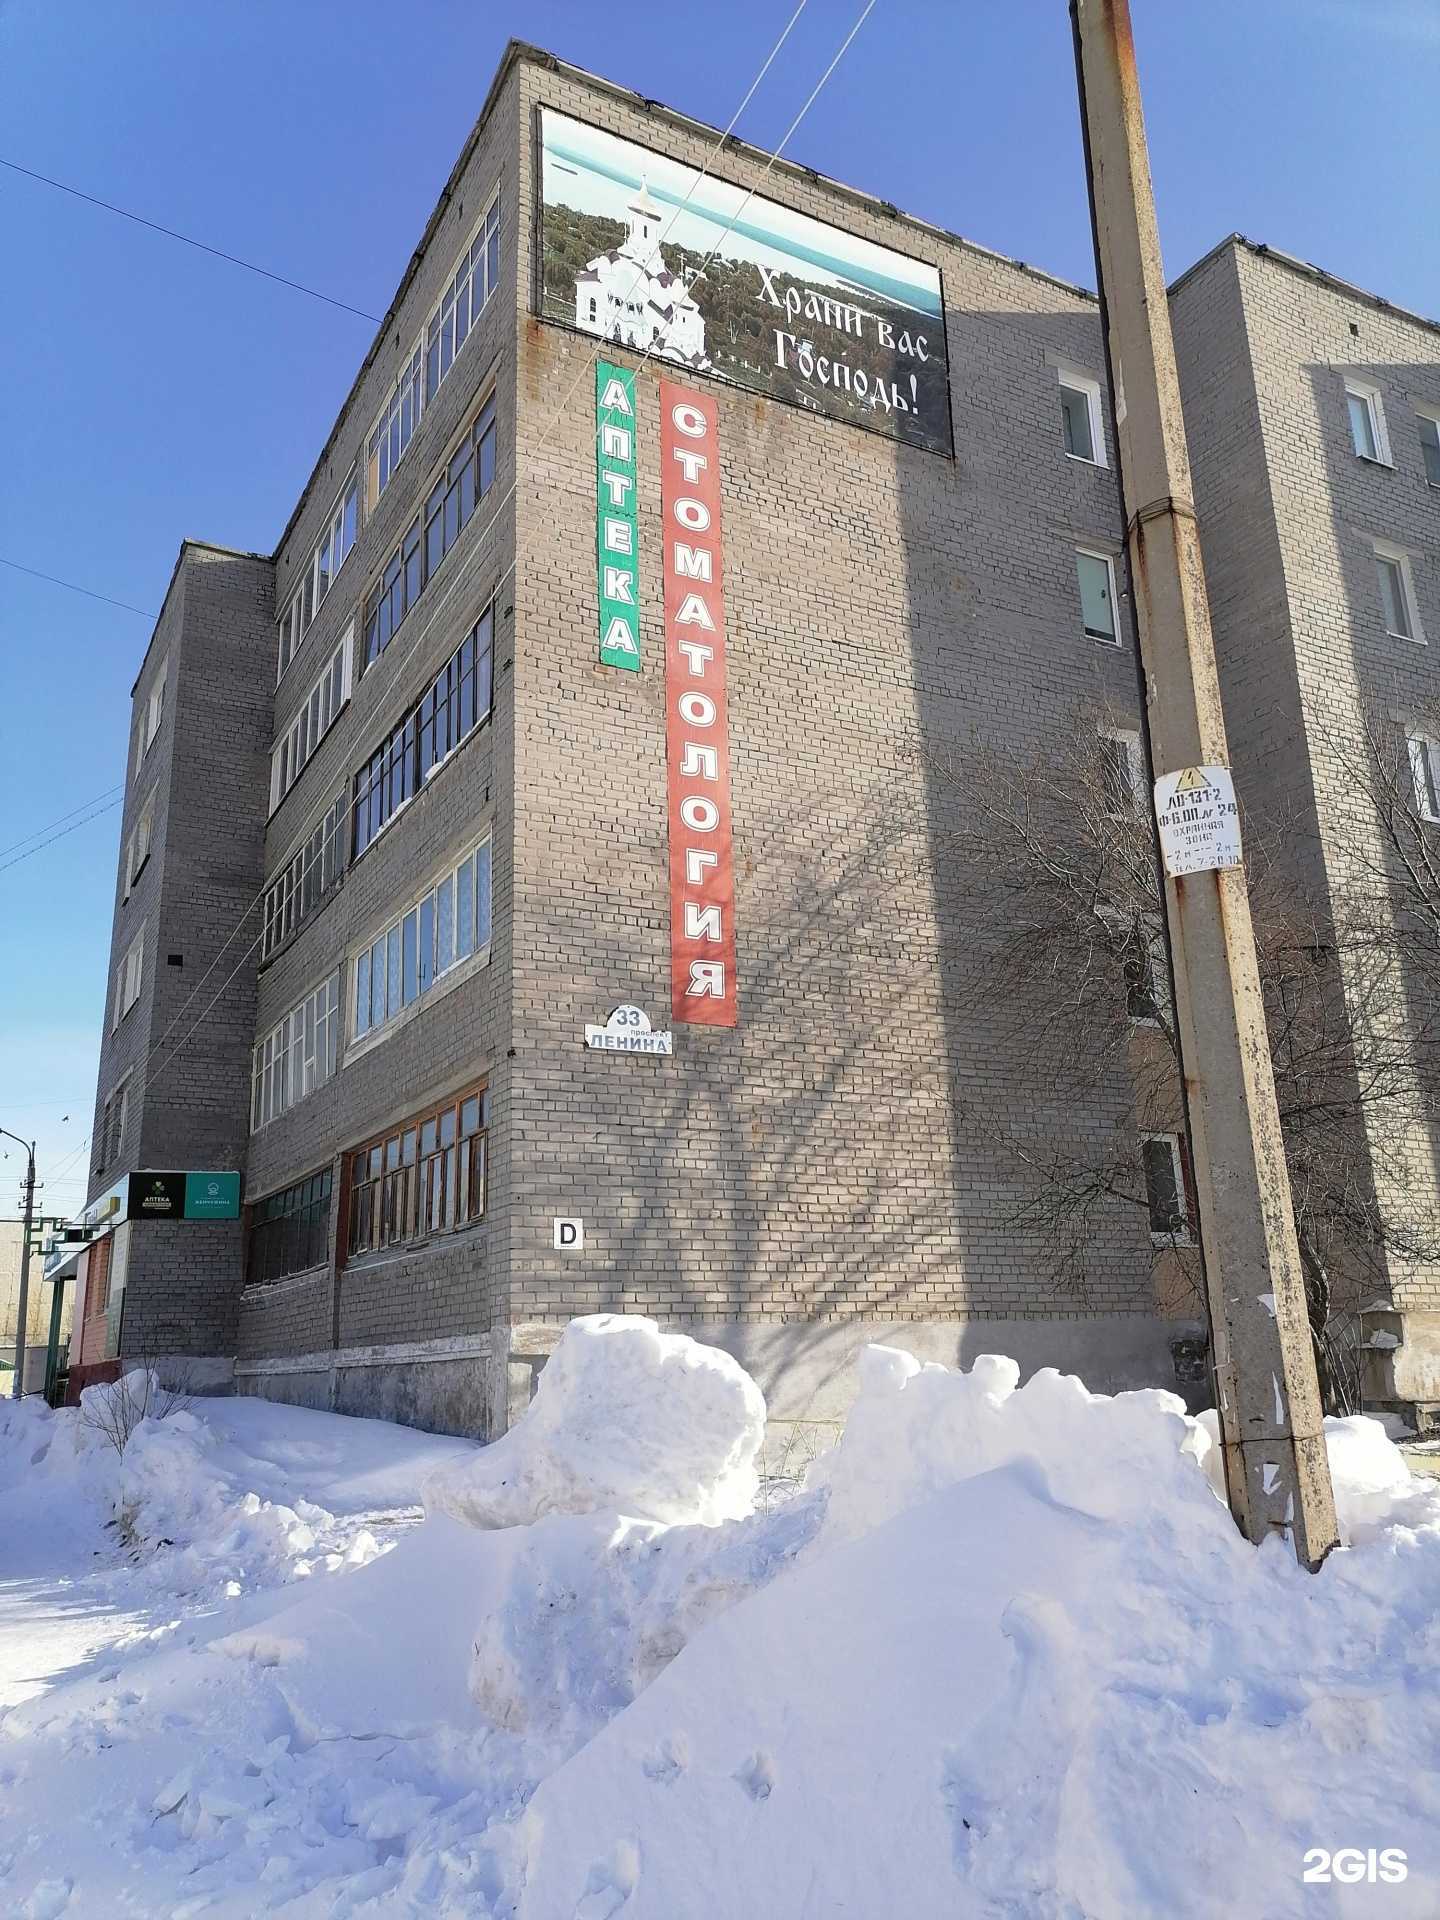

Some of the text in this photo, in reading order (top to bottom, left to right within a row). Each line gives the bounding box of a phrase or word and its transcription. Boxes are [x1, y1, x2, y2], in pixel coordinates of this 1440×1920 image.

[755, 264, 929, 362] Храни вас
[773, 328, 919, 415] Господь!
[600, 378, 638, 655] АПТЕКА
[672, 403, 726, 999] СТОМАТОЛОГИЯ
[1173, 820, 1224, 837] ОХРАННАЯ
[590, 1034, 667, 1052] ЛЕНИНА
[616, 1009, 640, 1027] 33
[560, 1223, 577, 1245] D
